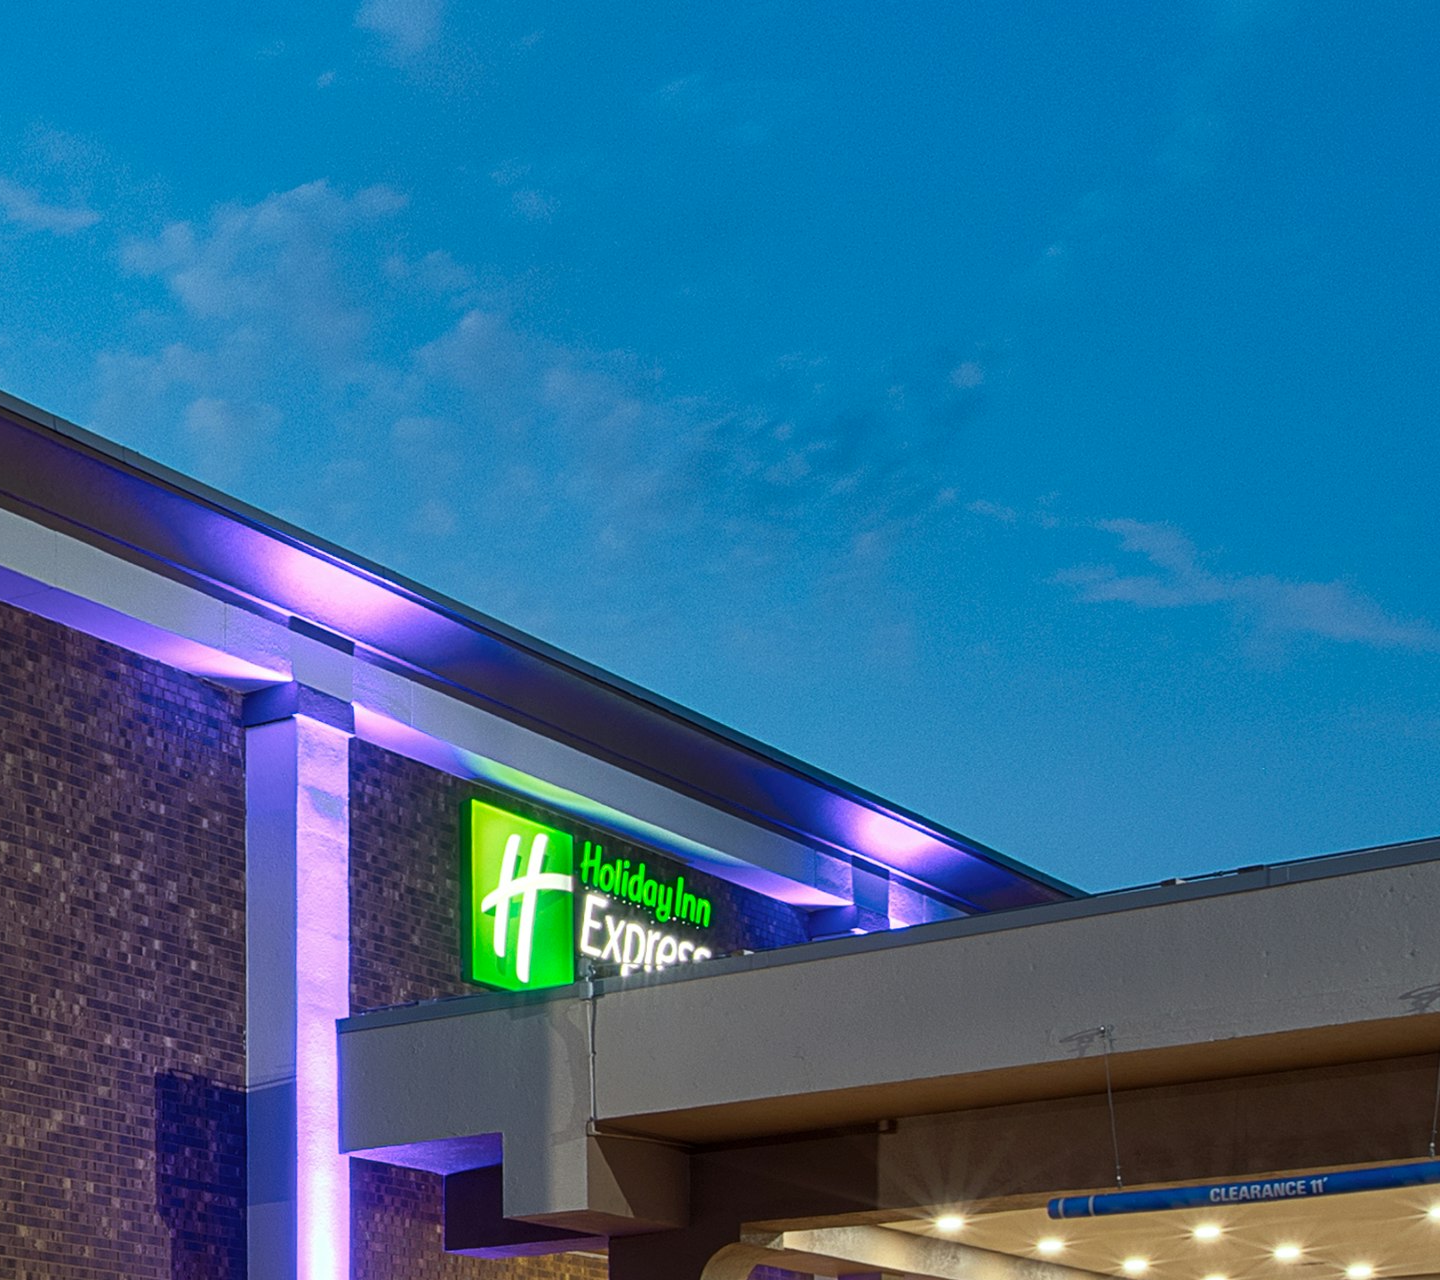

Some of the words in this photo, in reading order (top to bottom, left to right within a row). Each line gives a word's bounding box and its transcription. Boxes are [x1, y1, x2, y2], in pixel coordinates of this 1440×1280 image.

[580, 841, 673, 922] Holiday
[674, 876, 711, 928] Inn
[1209, 1180, 1307, 1203] CLEARANCE
